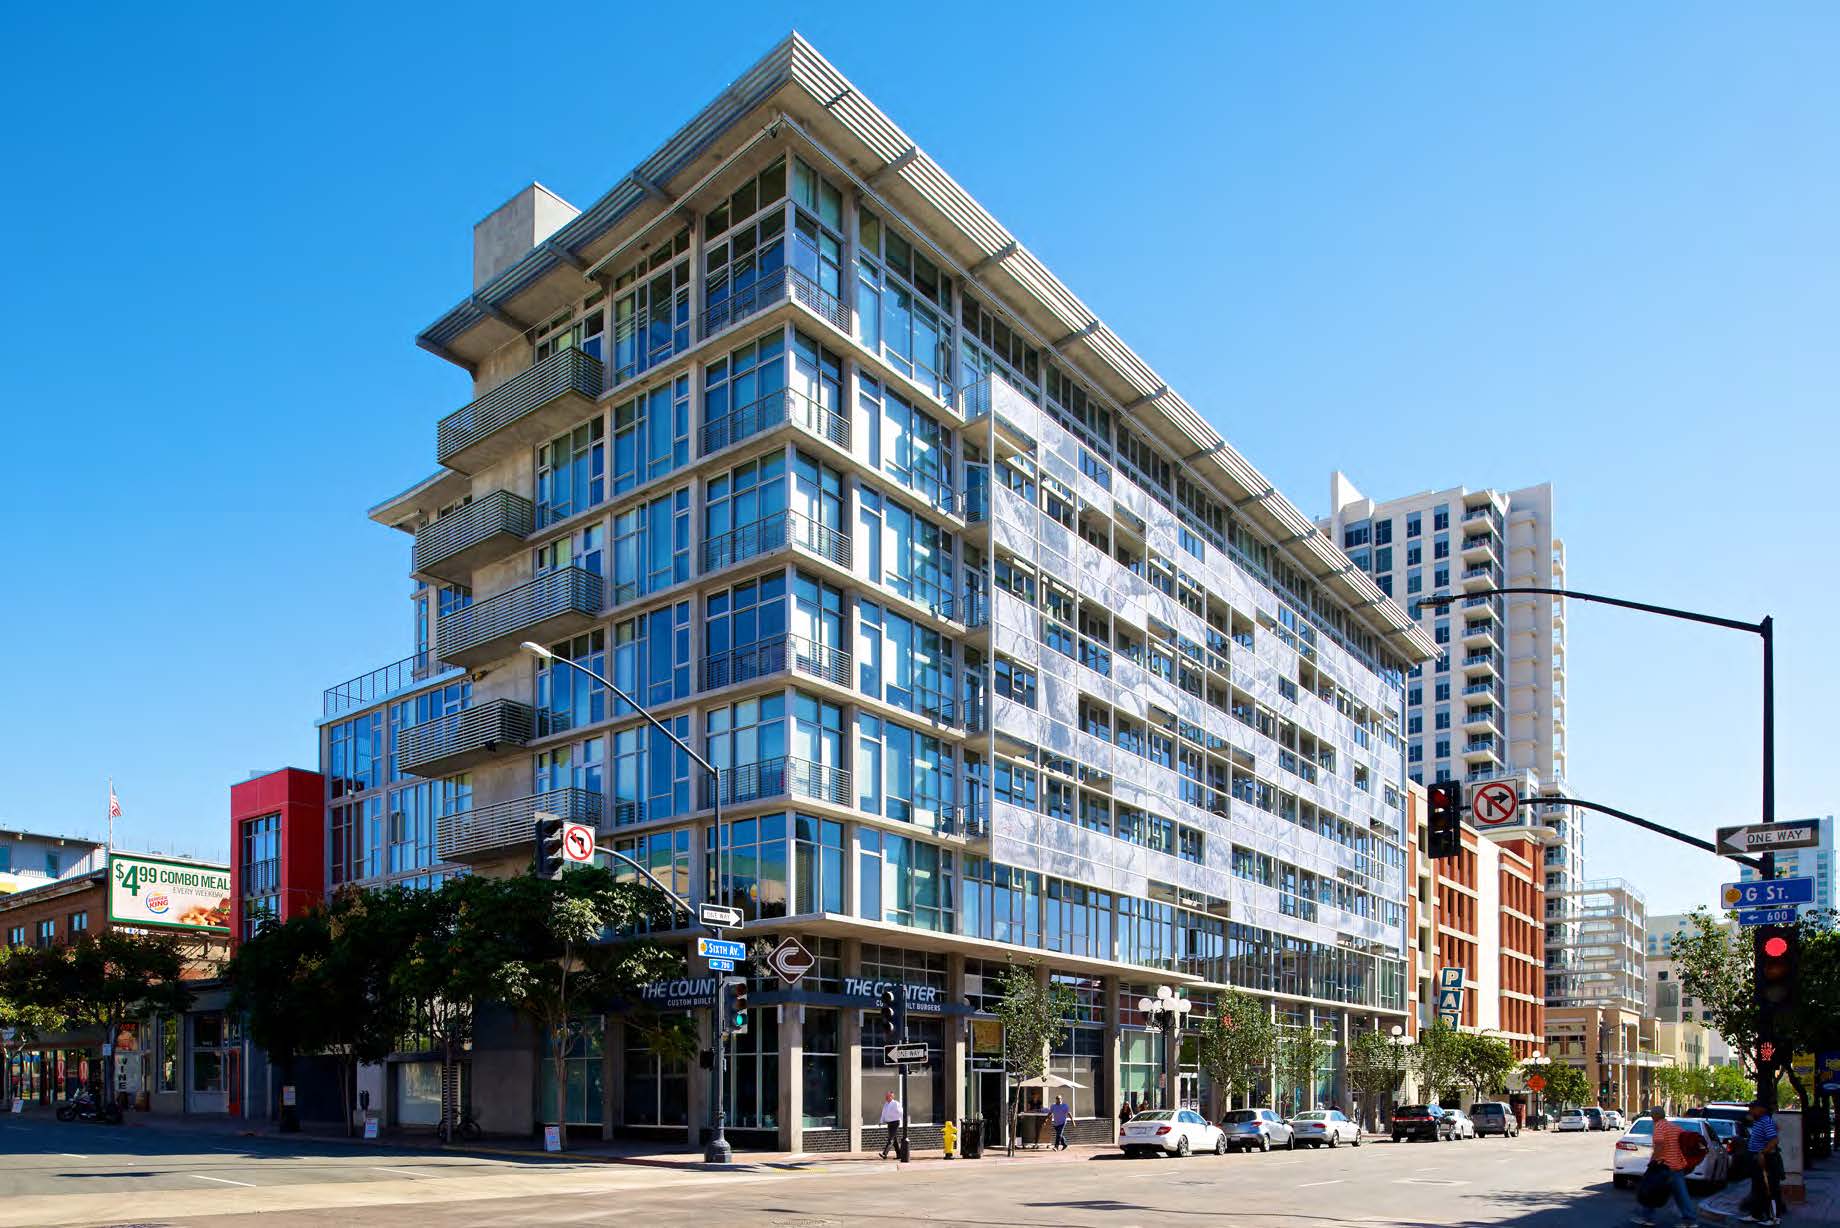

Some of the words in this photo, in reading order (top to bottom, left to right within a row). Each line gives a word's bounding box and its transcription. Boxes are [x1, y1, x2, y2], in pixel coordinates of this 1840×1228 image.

[1747, 832, 1772, 844] ONE
[1777, 830, 1803, 841] WAY
[160, 870, 199, 887] COMBO
[201, 875, 230, 890] MEAL
[173, 886, 193, 896] EVERY
[1746, 887, 1758, 901] G
[149, 899, 169, 908] KING
[706, 911, 718, 919] ONE
[1767, 911, 1788, 921] 600
[641, 982, 667, 998] THE
[669, 979, 716, 997] COUNT
[844, 978, 873, 996] THE
[873, 981, 937, 1002] CNTER
[667, 999, 692, 1007] CUSTOM
[1442, 970, 1459, 1030] PAR
[916, 1003, 941, 1012] BURGERS
[897, 1050, 908, 1058] ONE
